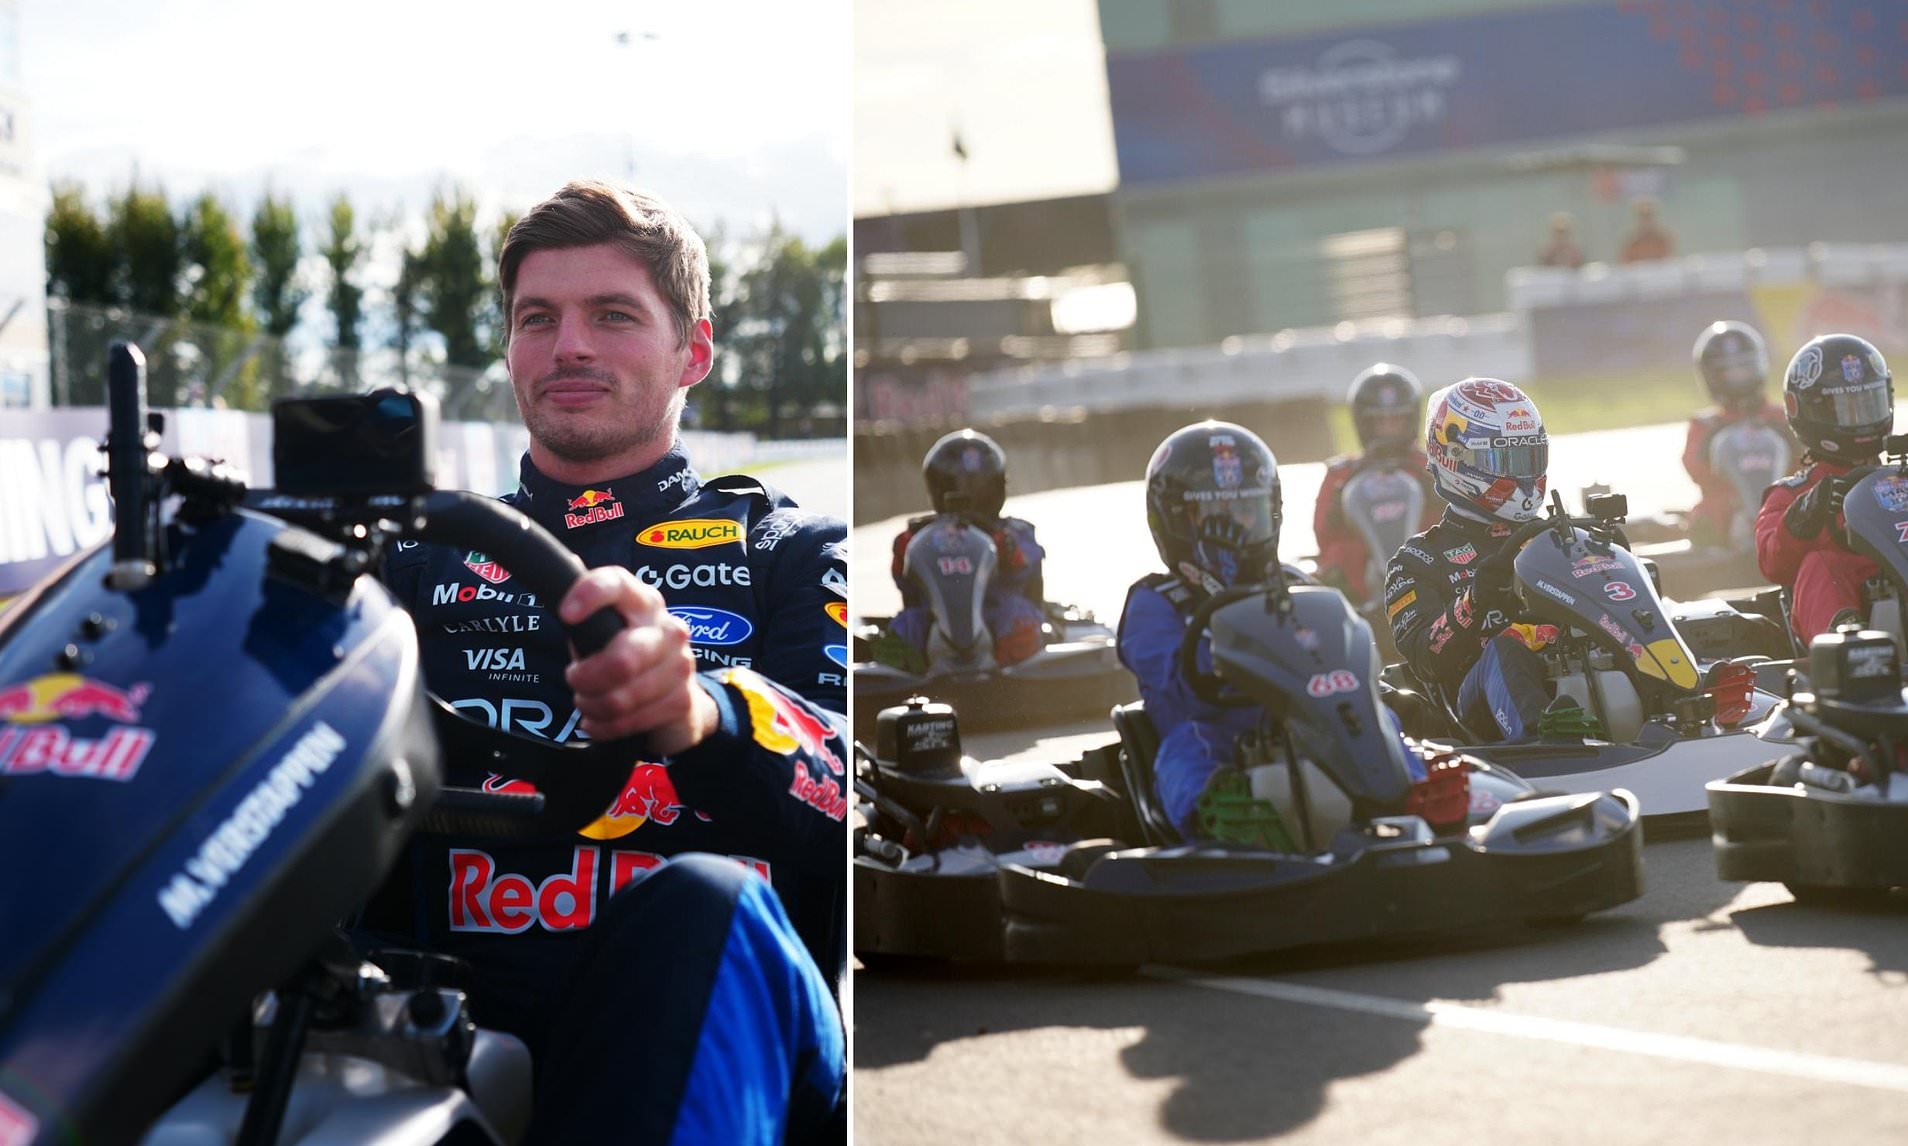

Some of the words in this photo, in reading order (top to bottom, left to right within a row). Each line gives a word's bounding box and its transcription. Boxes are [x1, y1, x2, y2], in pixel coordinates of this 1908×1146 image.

[1505, 421, 1522, 431] Red
[0, 437, 112, 563] ING
[565, 508, 596, 529] Red
[596, 501, 624, 523] Bull
[666, 525, 737, 543] RAUCH
[665, 561, 752, 591] Gate
[1603, 581, 1637, 601] 3
[462, 647, 526, 671] VISA
[488, 673, 540, 684] INFINITE
[449, 847, 600, 934] Red
